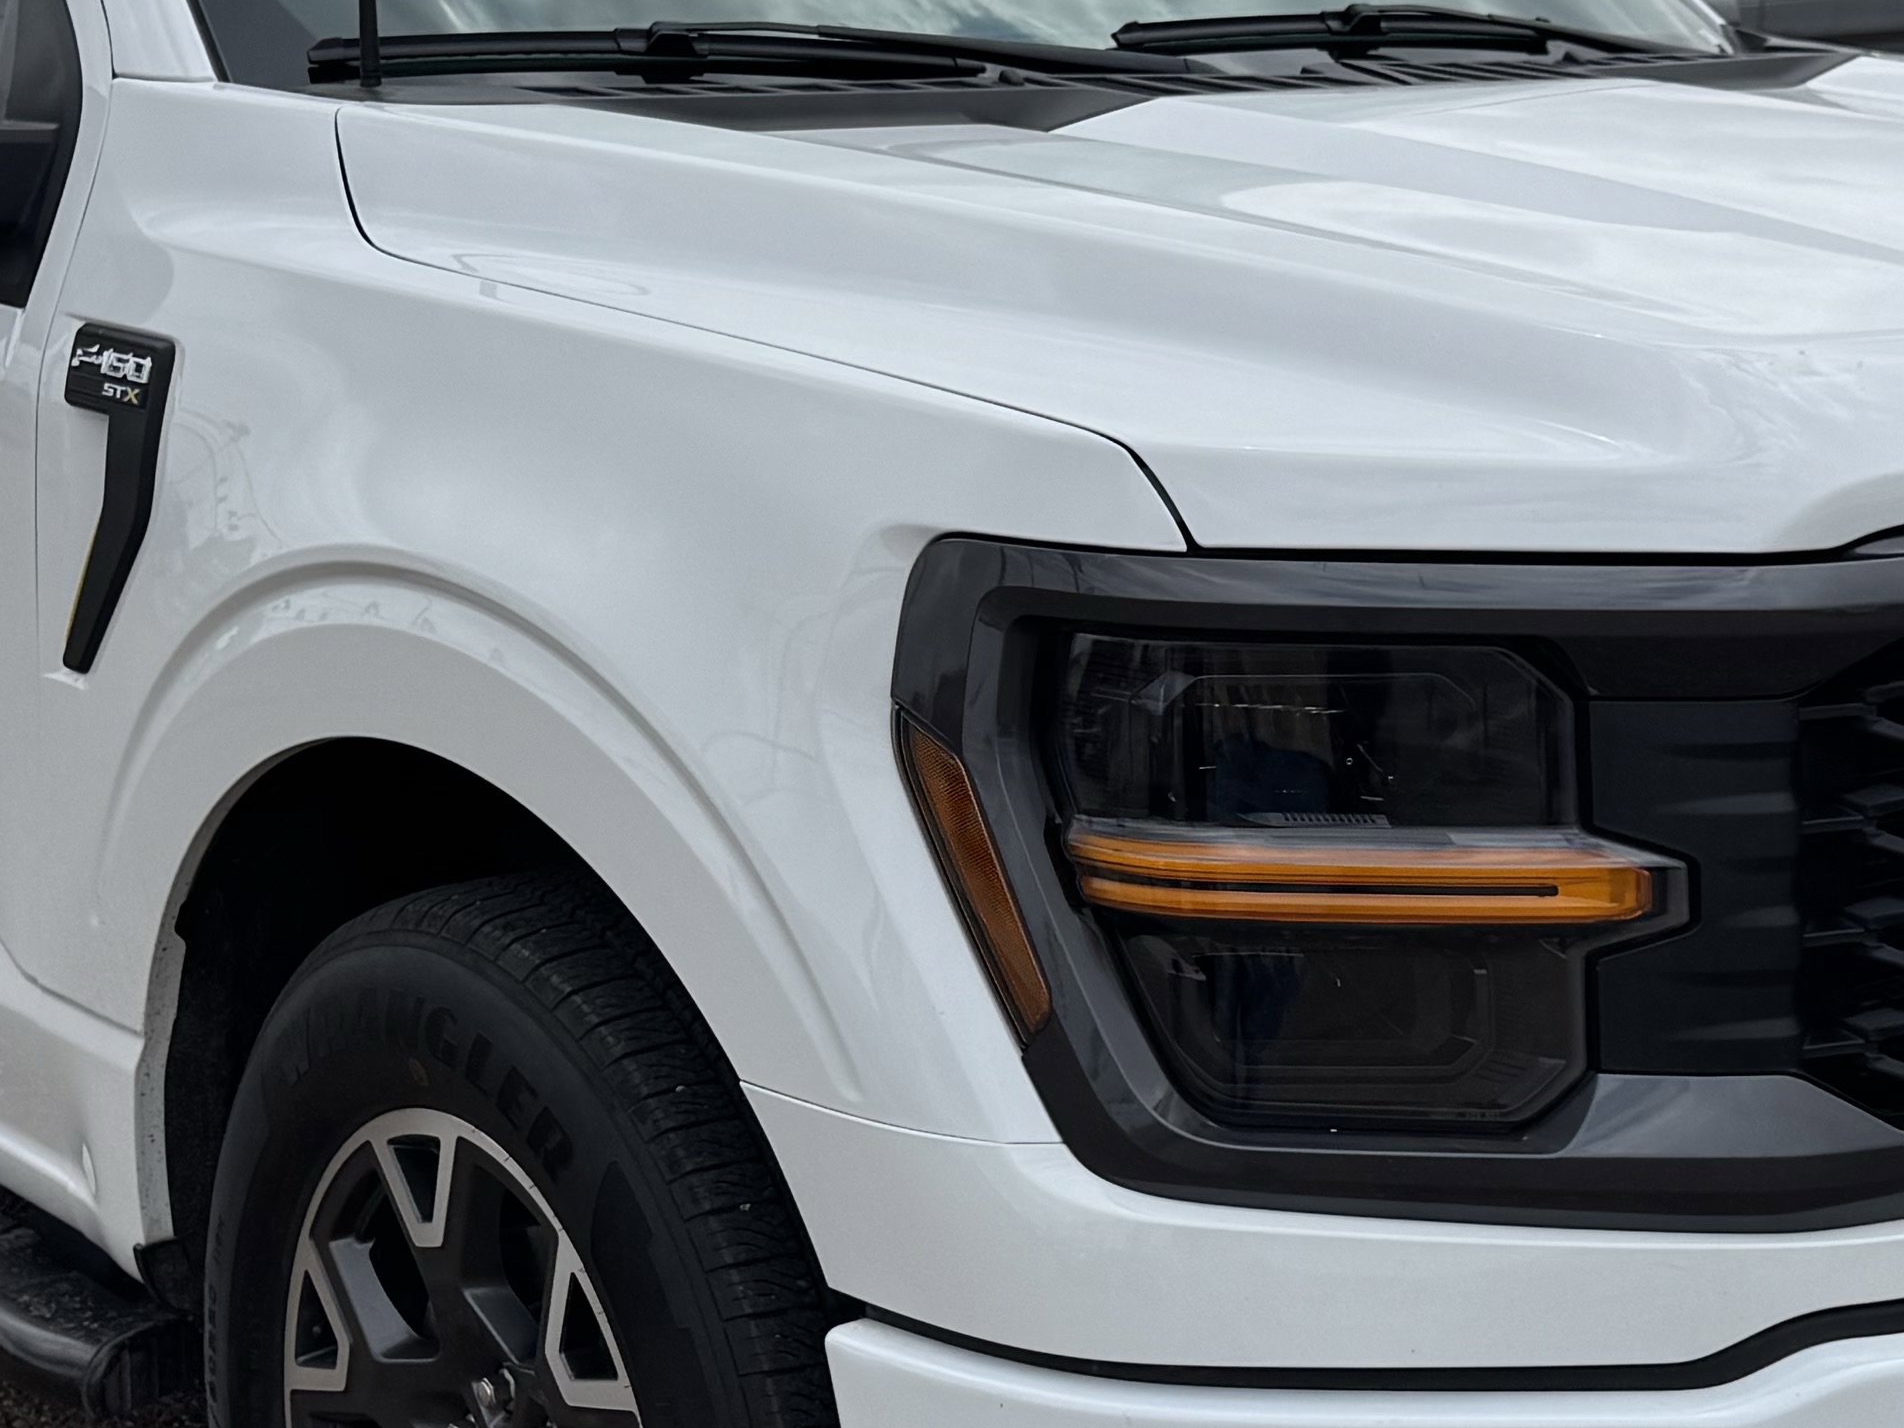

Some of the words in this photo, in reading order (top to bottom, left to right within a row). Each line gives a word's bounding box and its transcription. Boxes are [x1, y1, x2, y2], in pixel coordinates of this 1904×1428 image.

[71, 344, 152, 384] F-150
[102, 382, 140, 404] STX
[275, 988, 575, 1185] WRANGLER
